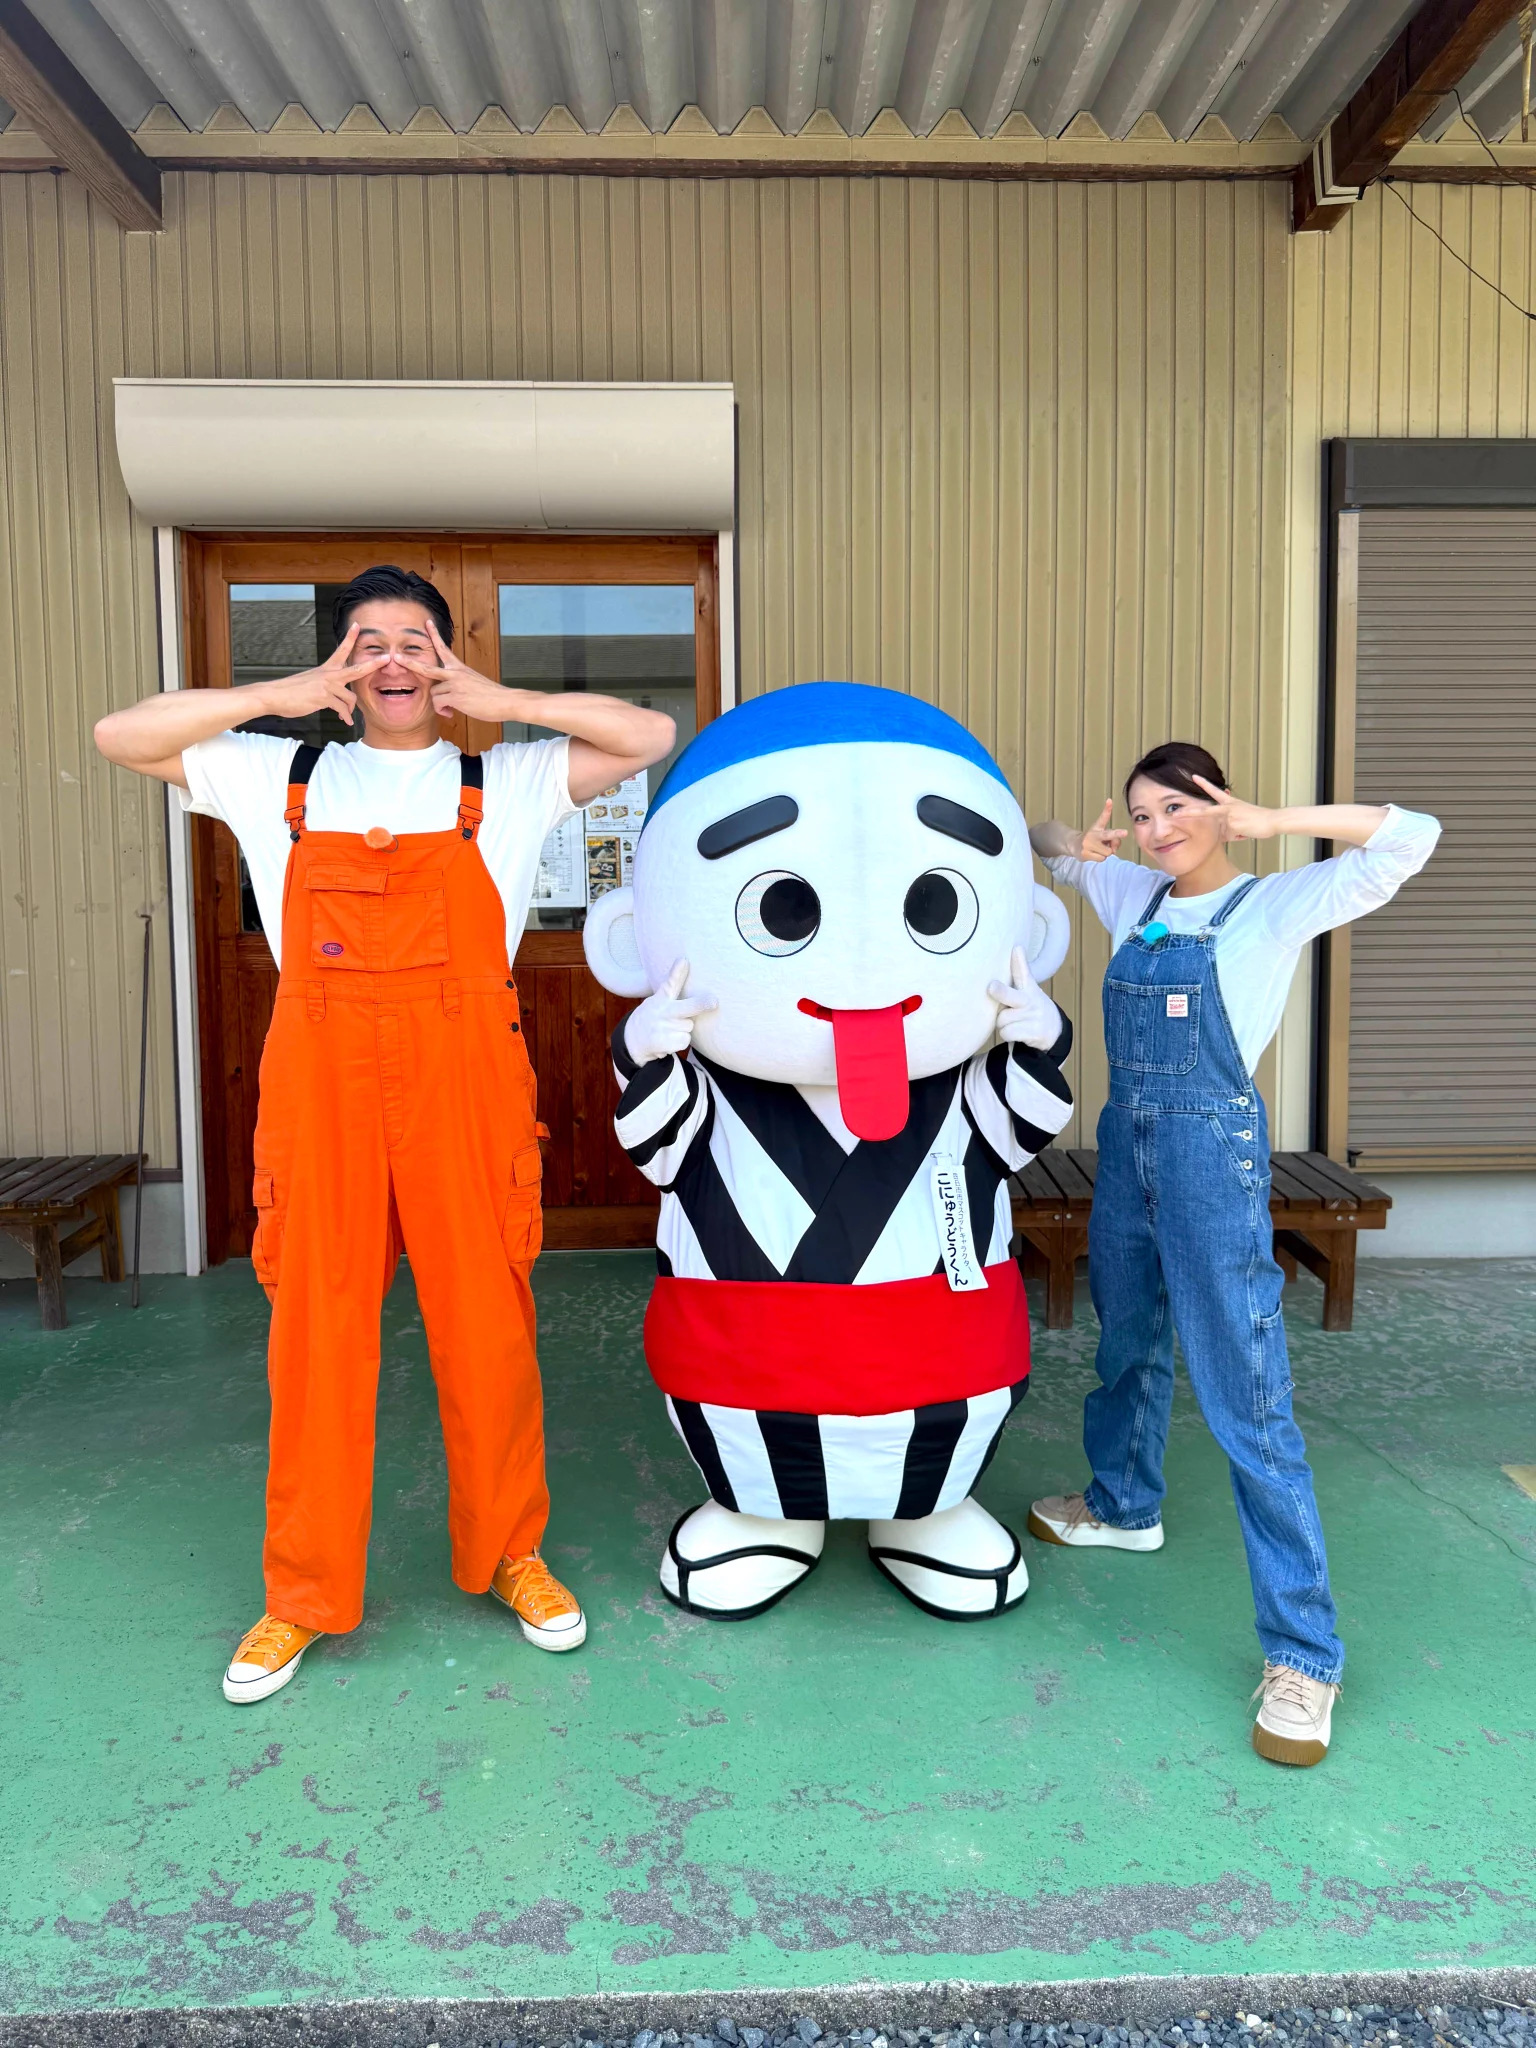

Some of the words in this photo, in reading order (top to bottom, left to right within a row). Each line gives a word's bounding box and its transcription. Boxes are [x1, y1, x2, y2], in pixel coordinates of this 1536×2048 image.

[937, 1172, 968, 1286] こにゅうどうくん
